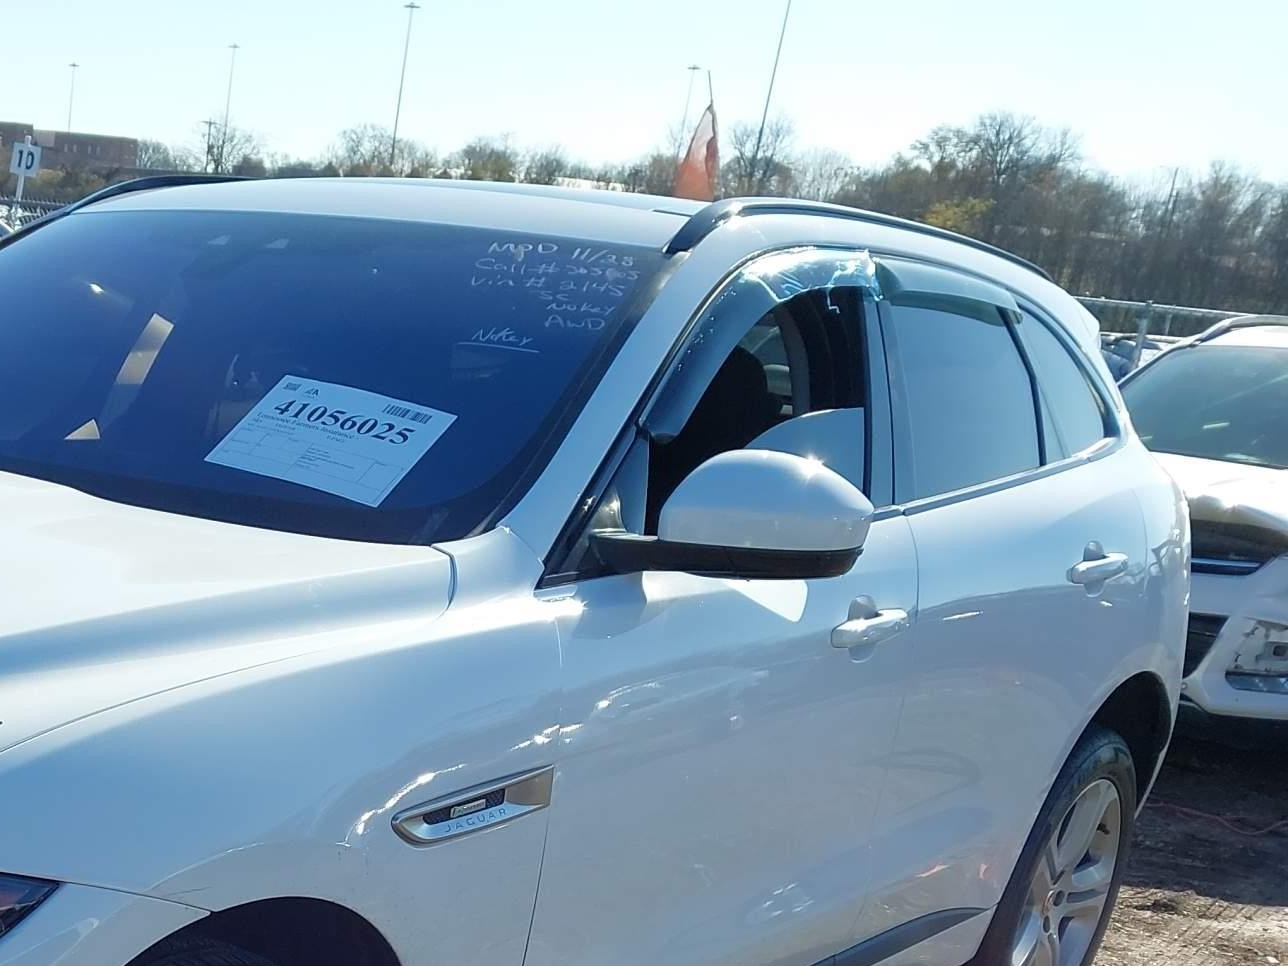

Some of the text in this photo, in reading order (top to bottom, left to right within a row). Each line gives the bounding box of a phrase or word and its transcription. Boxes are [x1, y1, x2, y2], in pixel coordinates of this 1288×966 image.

[17, 149, 35, 170] 10
[274, 399, 416, 445] 41056025
[445, 808, 507, 833] JAGUAR
